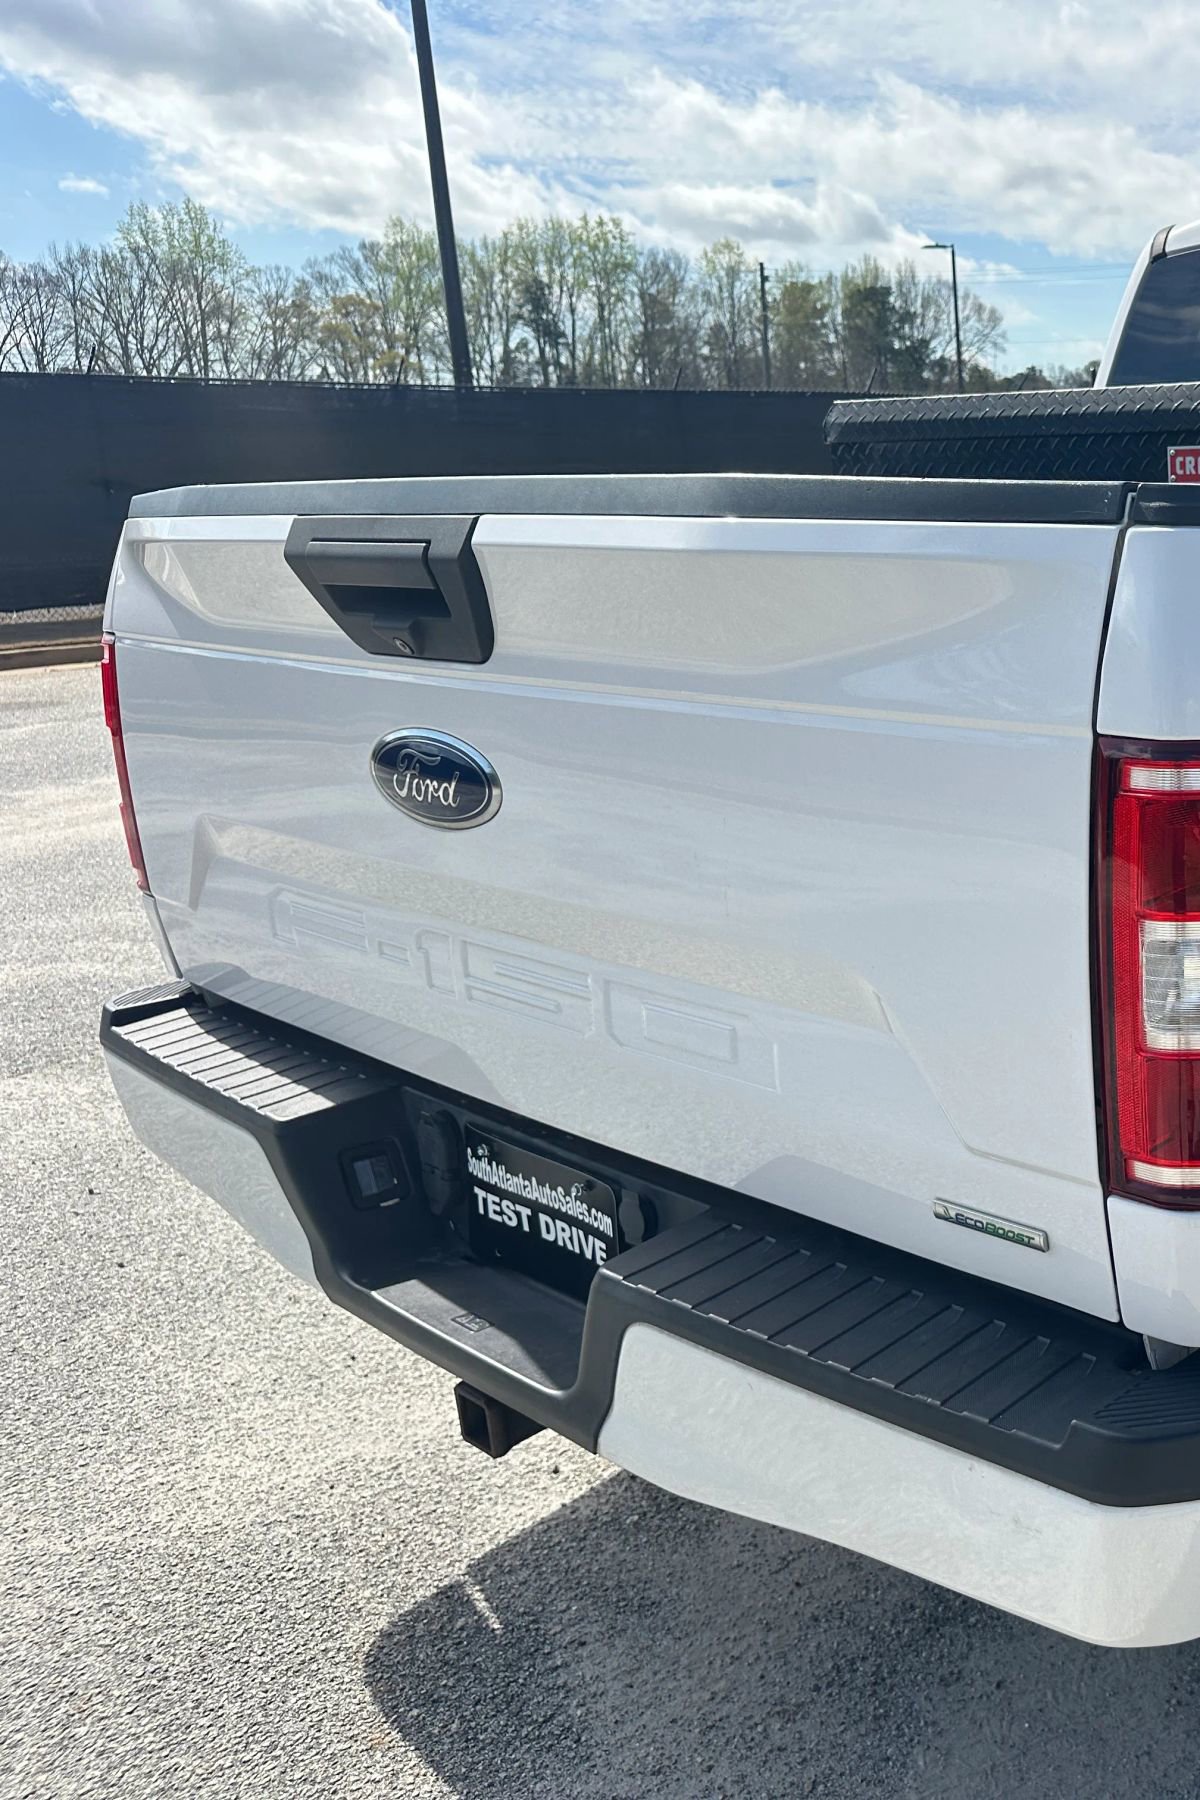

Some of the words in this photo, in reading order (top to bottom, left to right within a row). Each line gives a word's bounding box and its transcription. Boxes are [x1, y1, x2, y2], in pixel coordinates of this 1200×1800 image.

[393, 748, 460, 807] Ford
[271, 884, 781, 1093] F-150
[466, 1147, 613, 1238] SouthAtlantaAutoSales.com
[473, 1186, 532, 1232] TEST
[538, 1212, 607, 1266] DRIVE
